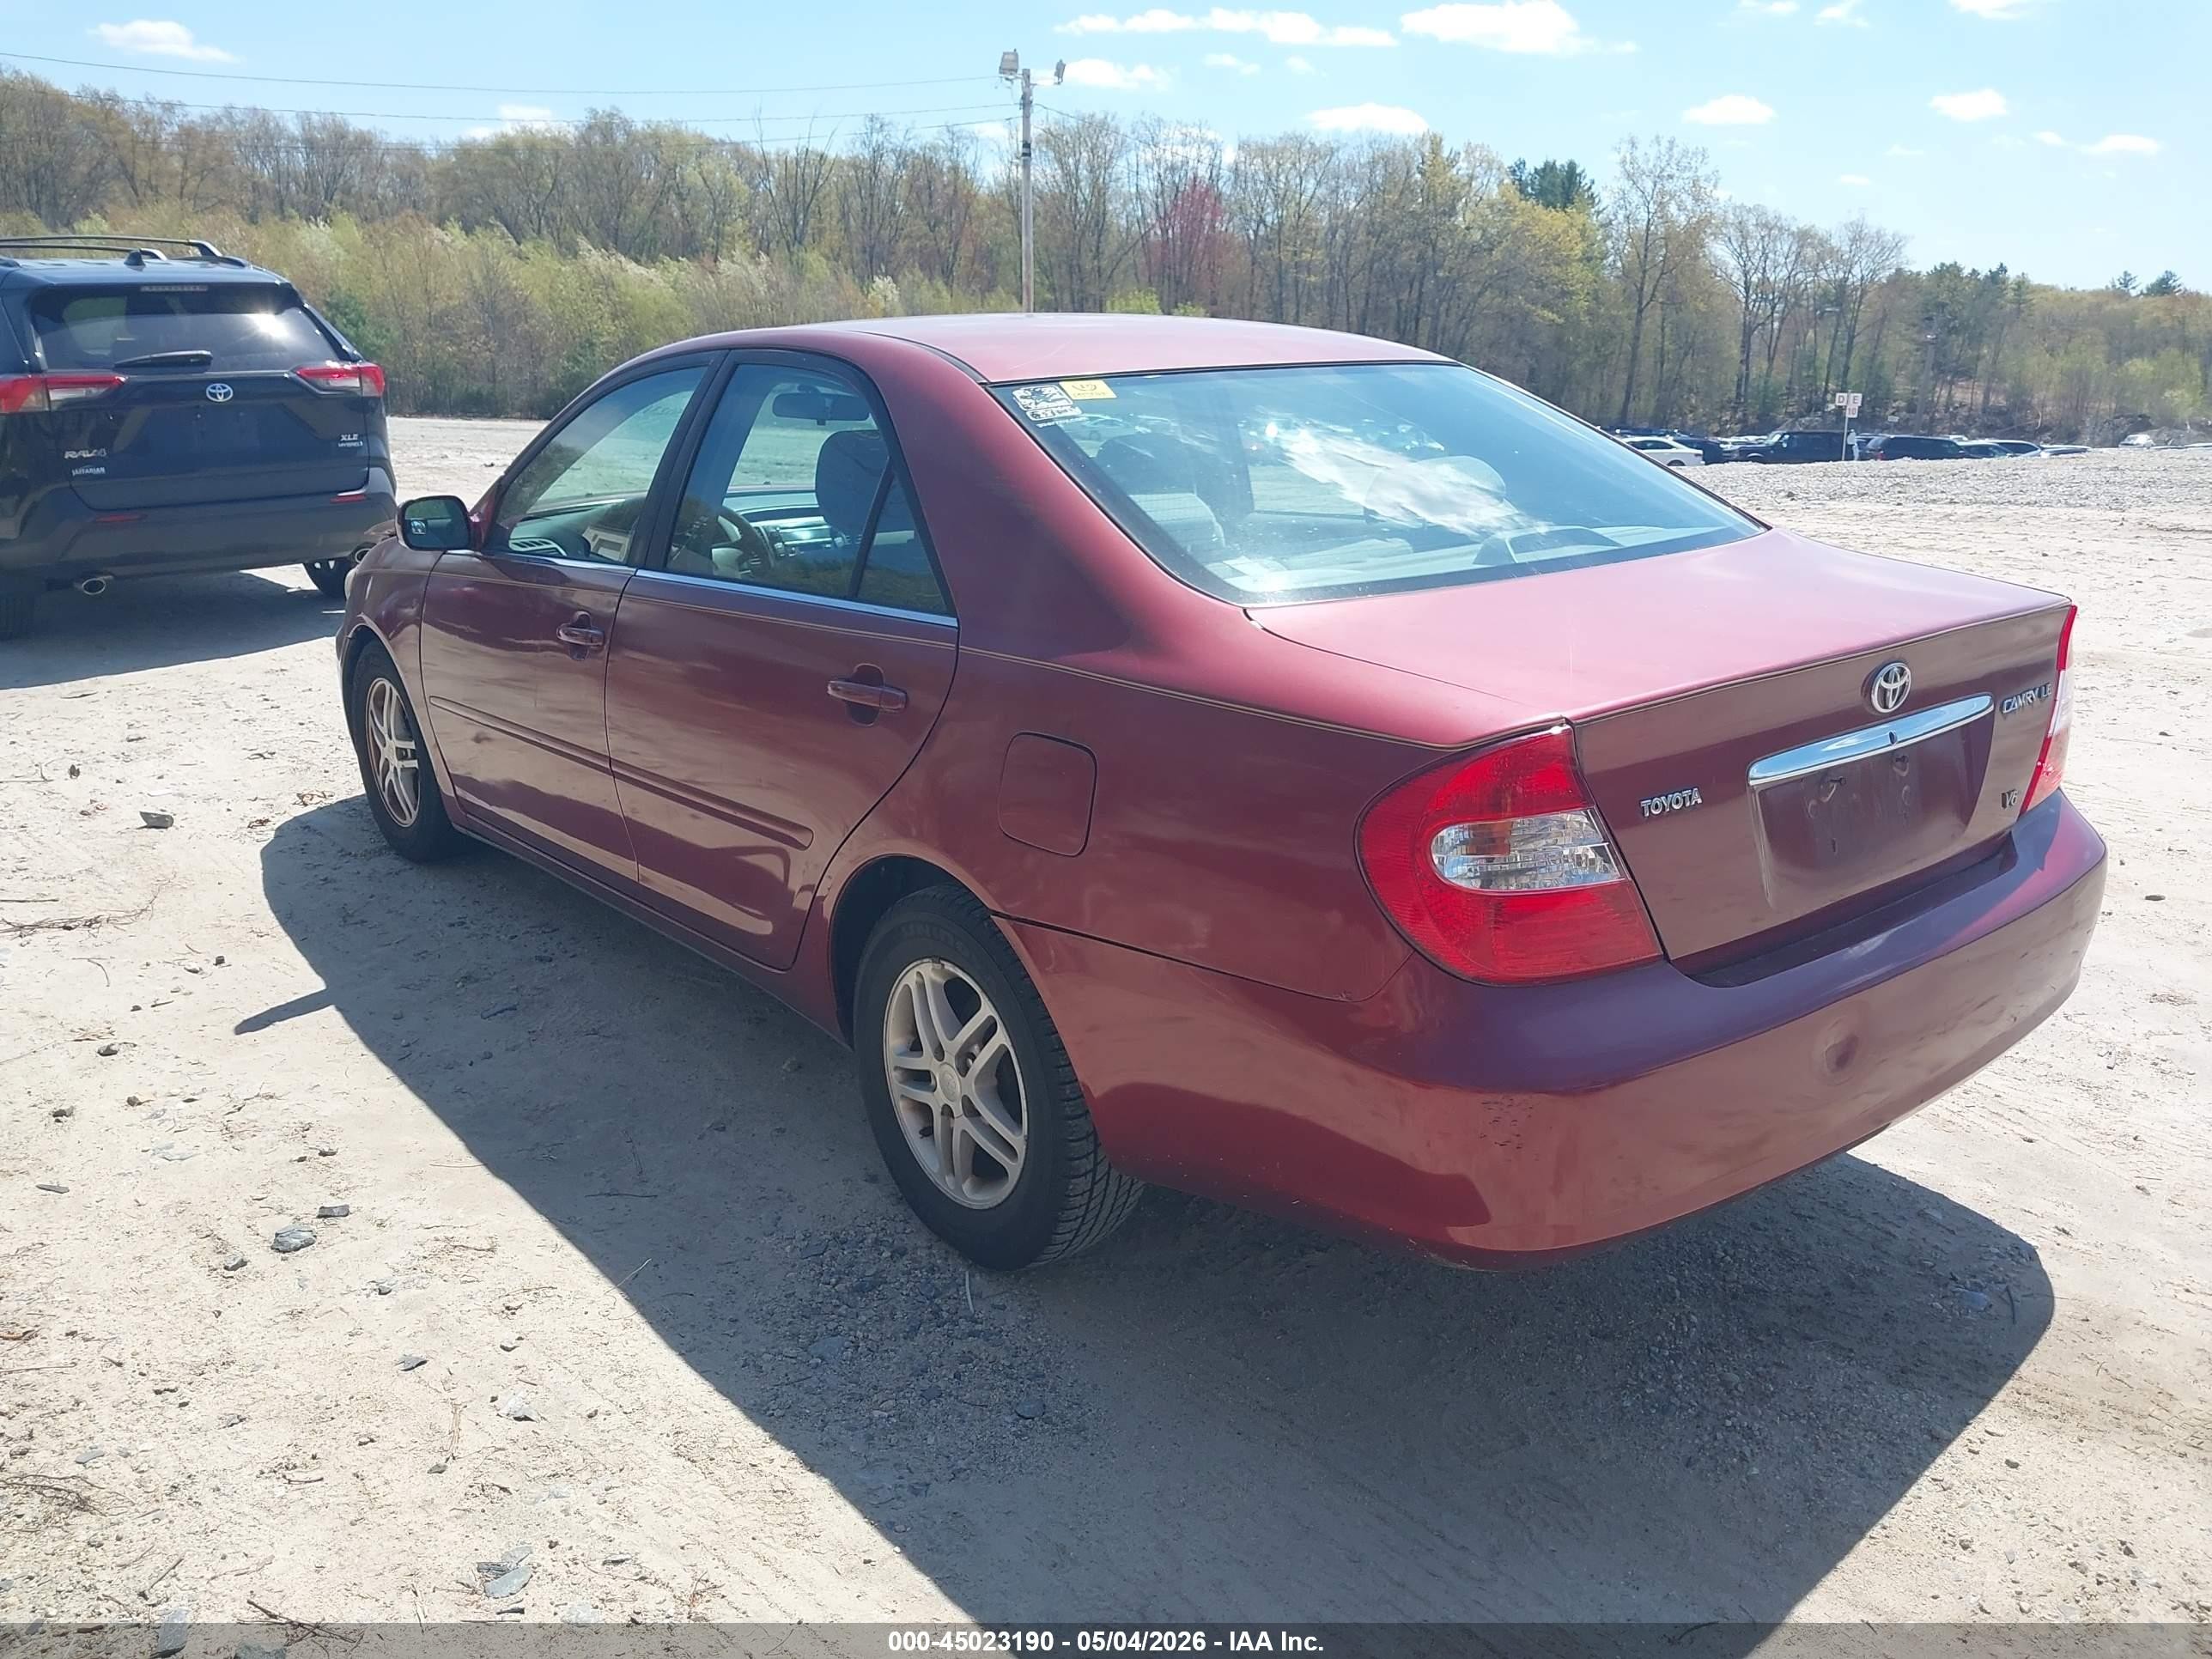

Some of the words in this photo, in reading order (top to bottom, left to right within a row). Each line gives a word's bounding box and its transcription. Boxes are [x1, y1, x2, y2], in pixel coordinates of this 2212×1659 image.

[1838, 395, 1845, 404] D
[1852, 395, 1860, 404] E
[1847, 407, 1857, 416] 10
[64, 447, 107, 459] RAV4
[2002, 686, 2041, 714] CAMRY
[2041, 683, 2052, 698] LE
[1640, 787, 1703, 817] TOYOTA
[2002, 789, 2018, 809] V6
